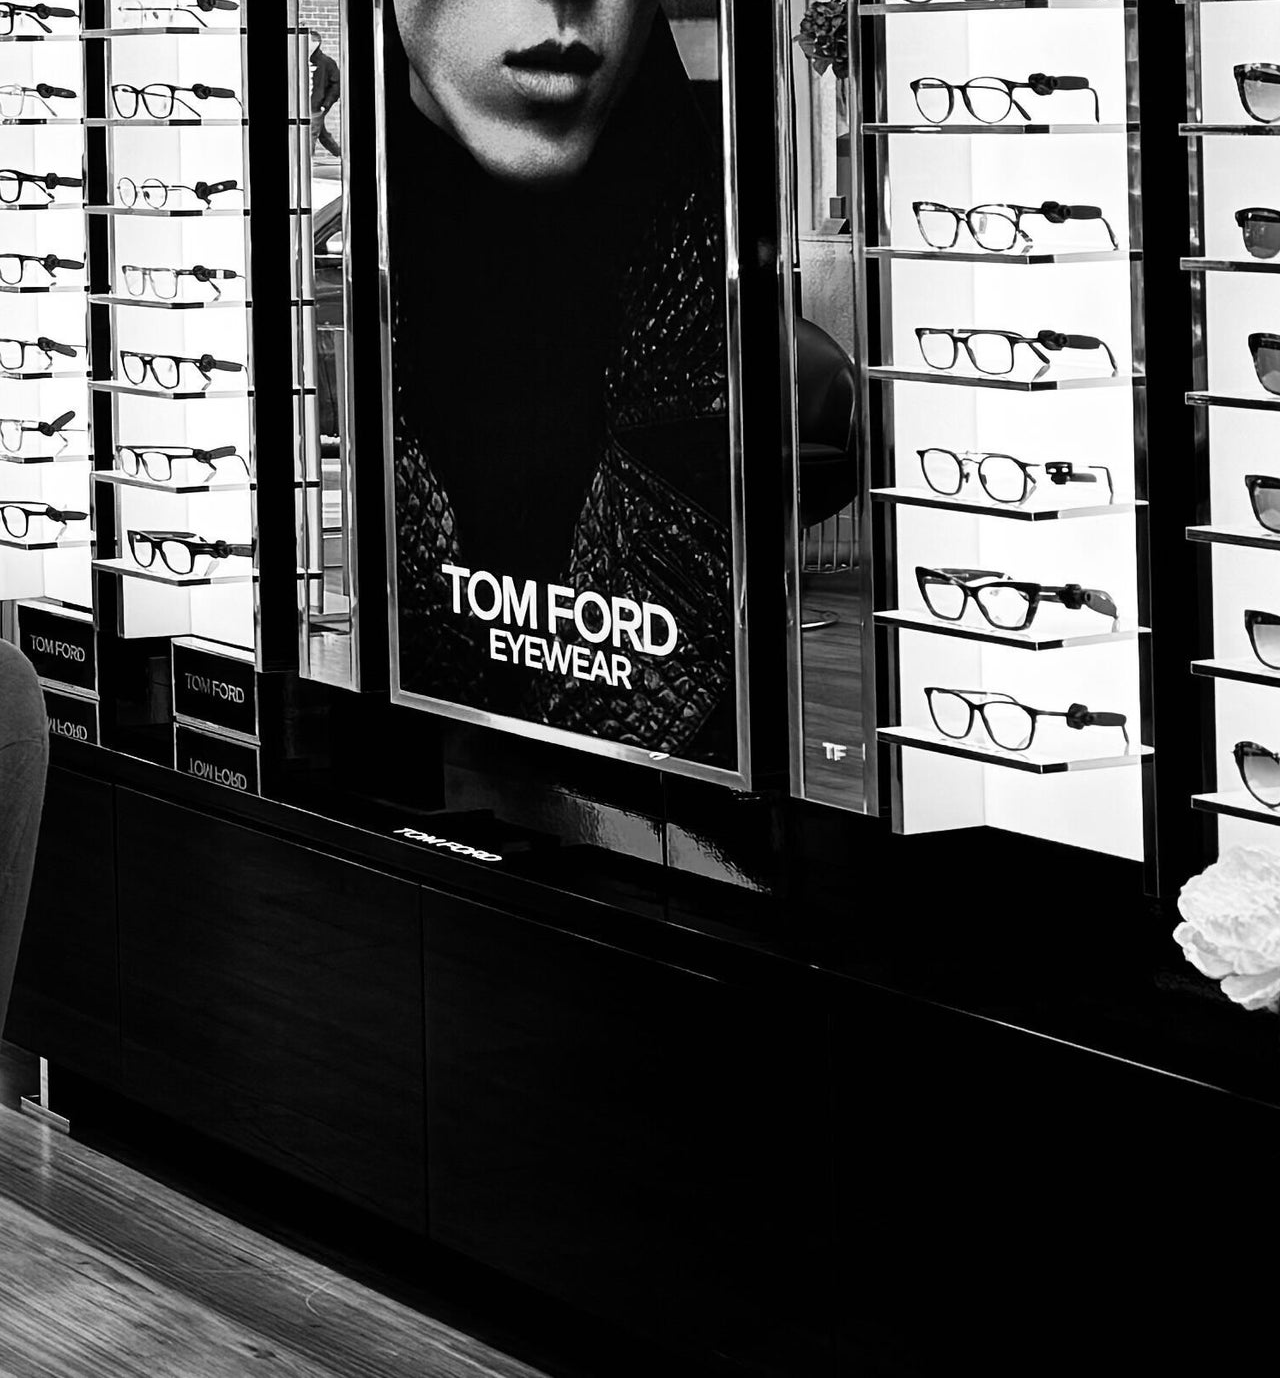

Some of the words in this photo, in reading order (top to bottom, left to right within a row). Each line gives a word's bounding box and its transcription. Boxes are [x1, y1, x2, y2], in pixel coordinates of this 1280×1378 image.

[441, 563, 538, 630] TOM
[547, 583, 679, 657] FORD
[29, 634, 54, 655] TOM
[55, 641, 86, 662] FORD
[490, 627, 633, 690] EYEWEAR
[185, 672, 211, 695] TOM
[212, 680, 245, 704] FORD
[822, 741, 847, 761] TF
